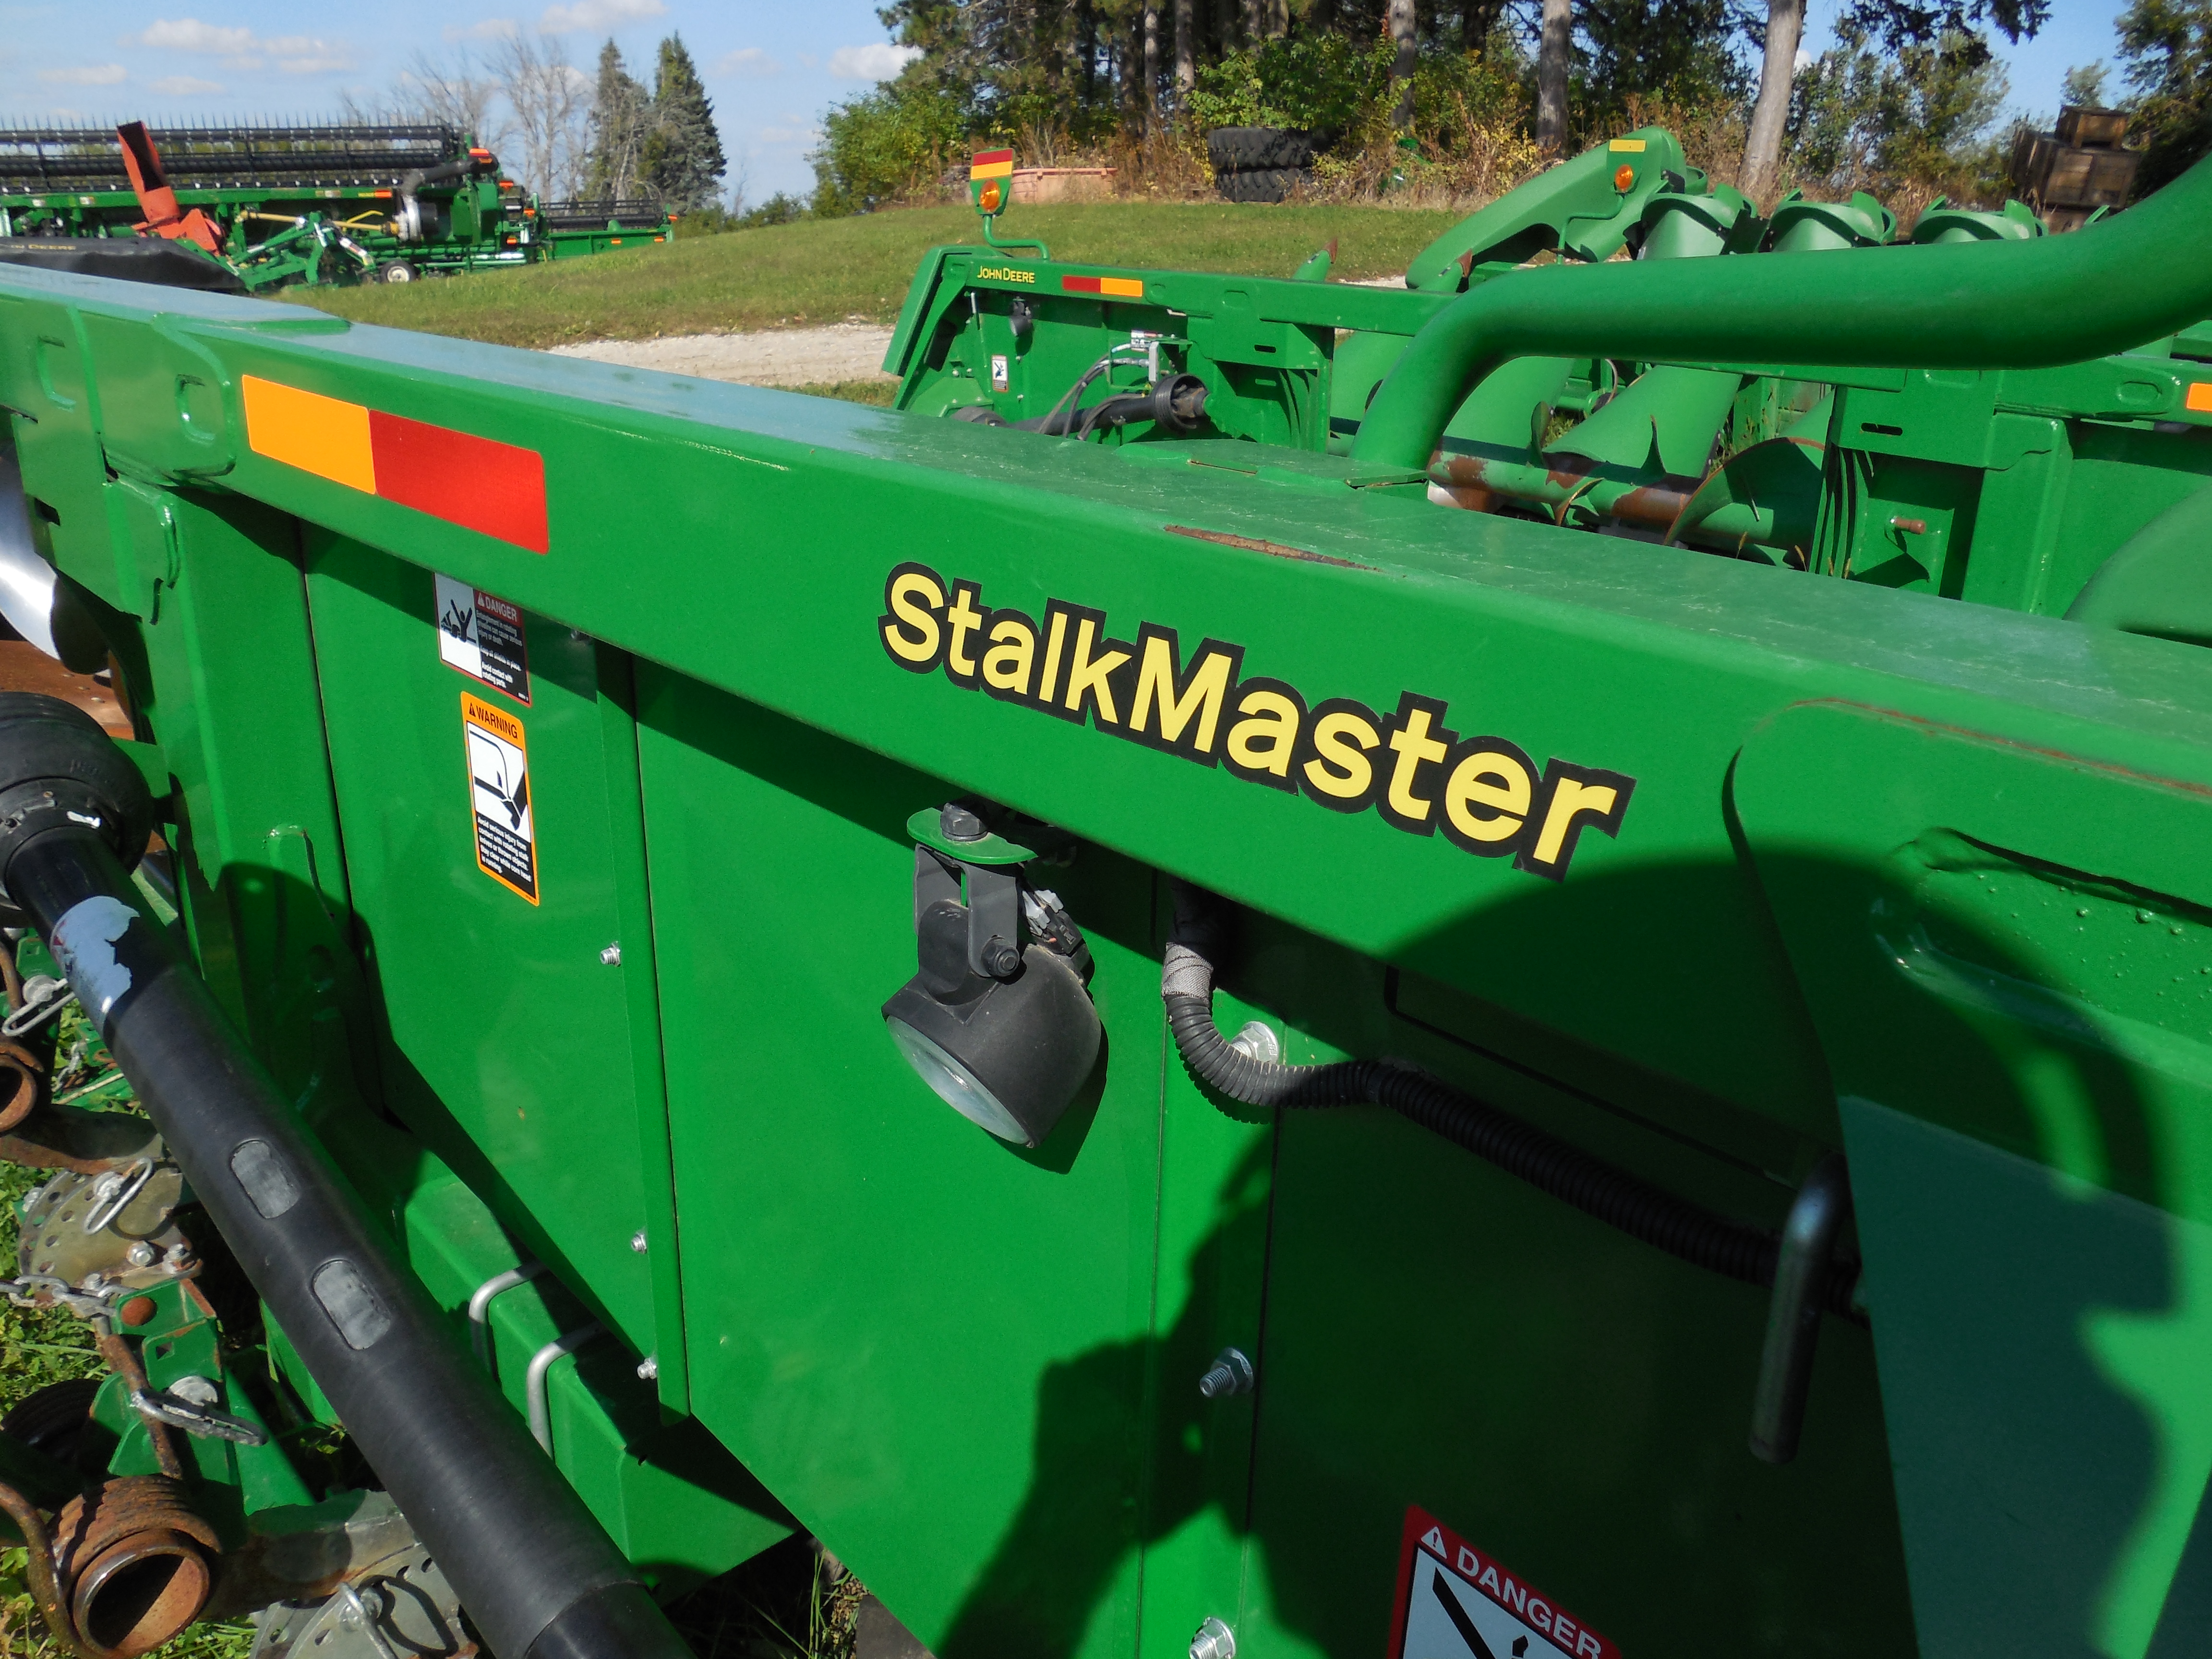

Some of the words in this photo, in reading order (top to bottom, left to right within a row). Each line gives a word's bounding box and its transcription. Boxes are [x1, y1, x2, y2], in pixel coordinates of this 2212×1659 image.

[977, 265, 1002, 280] JOHN
[1003, 267, 1035, 283] DEERE
[485, 596, 517, 622] DANGER
[476, 705, 518, 739] WARNING
[882, 569, 1625, 873] StalkMaster
[478, 827, 493, 840] contact
[520, 869, 532, 883] head
[1456, 1545, 1603, 1659] DANGER
